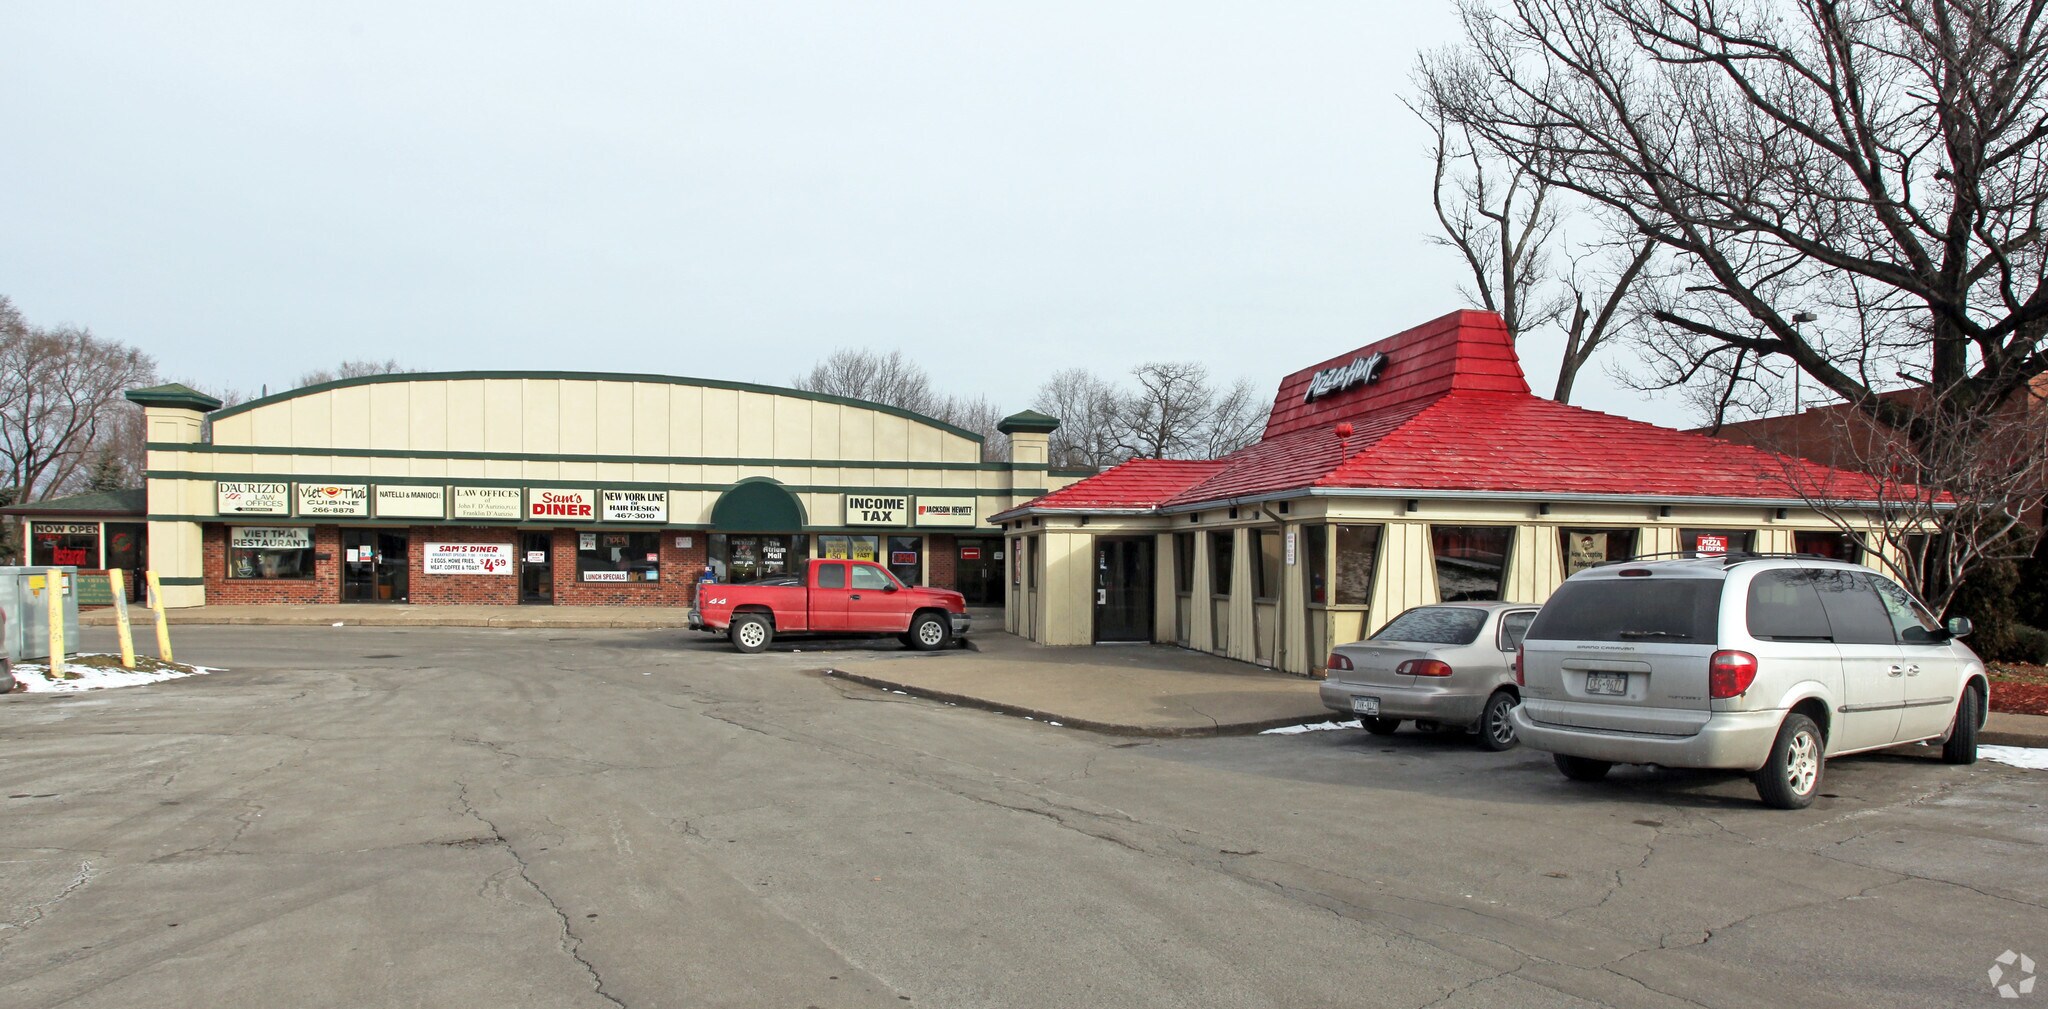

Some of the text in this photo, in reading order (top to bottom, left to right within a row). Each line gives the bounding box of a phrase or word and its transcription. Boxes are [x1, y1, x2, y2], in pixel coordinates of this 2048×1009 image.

[1303, 366, 1348, 401] Pizza
[219, 483, 286, 494] D'AURIZIO
[299, 486, 367, 499] Viet Thai
[479, 490, 520, 498] OFFICES
[542, 492, 583, 504] Sam's
[605, 492, 664, 502] NEW YORK LINE
[850, 498, 904, 510] INCOME
[533, 504, 591, 516] DINER
[861, 511, 892, 522] TAX
[36, 525, 98, 534] NOW OPEN
[243, 530, 297, 538] VIET THAI
[233, 539, 307, 547] RESTAURANT
[439, 545, 468, 553] SAM'S
